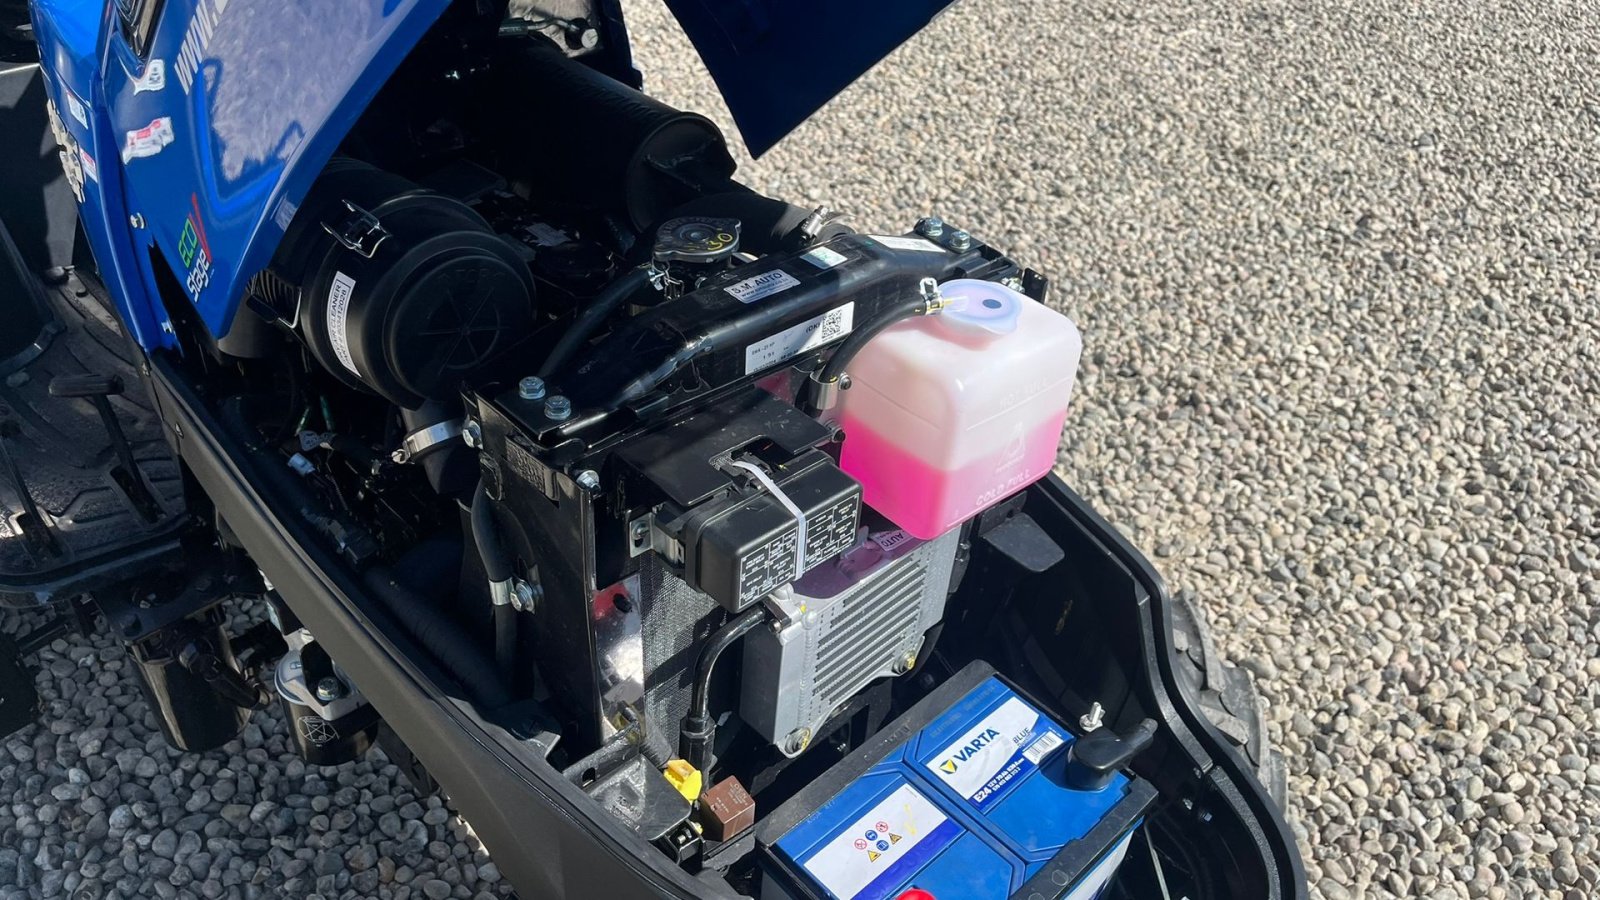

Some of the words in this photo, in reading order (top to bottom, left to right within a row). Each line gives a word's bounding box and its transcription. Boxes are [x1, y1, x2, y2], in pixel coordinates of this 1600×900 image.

[178, 218, 199, 268] ECO
[186, 248, 210, 303] Stage
[754, 272, 783, 286] AUTO
[880, 532, 904, 547] AUTO
[1012, 727, 1031, 744] BLUE
[952, 728, 1000, 762] VARTA
[973, 786, 993, 803] E24
